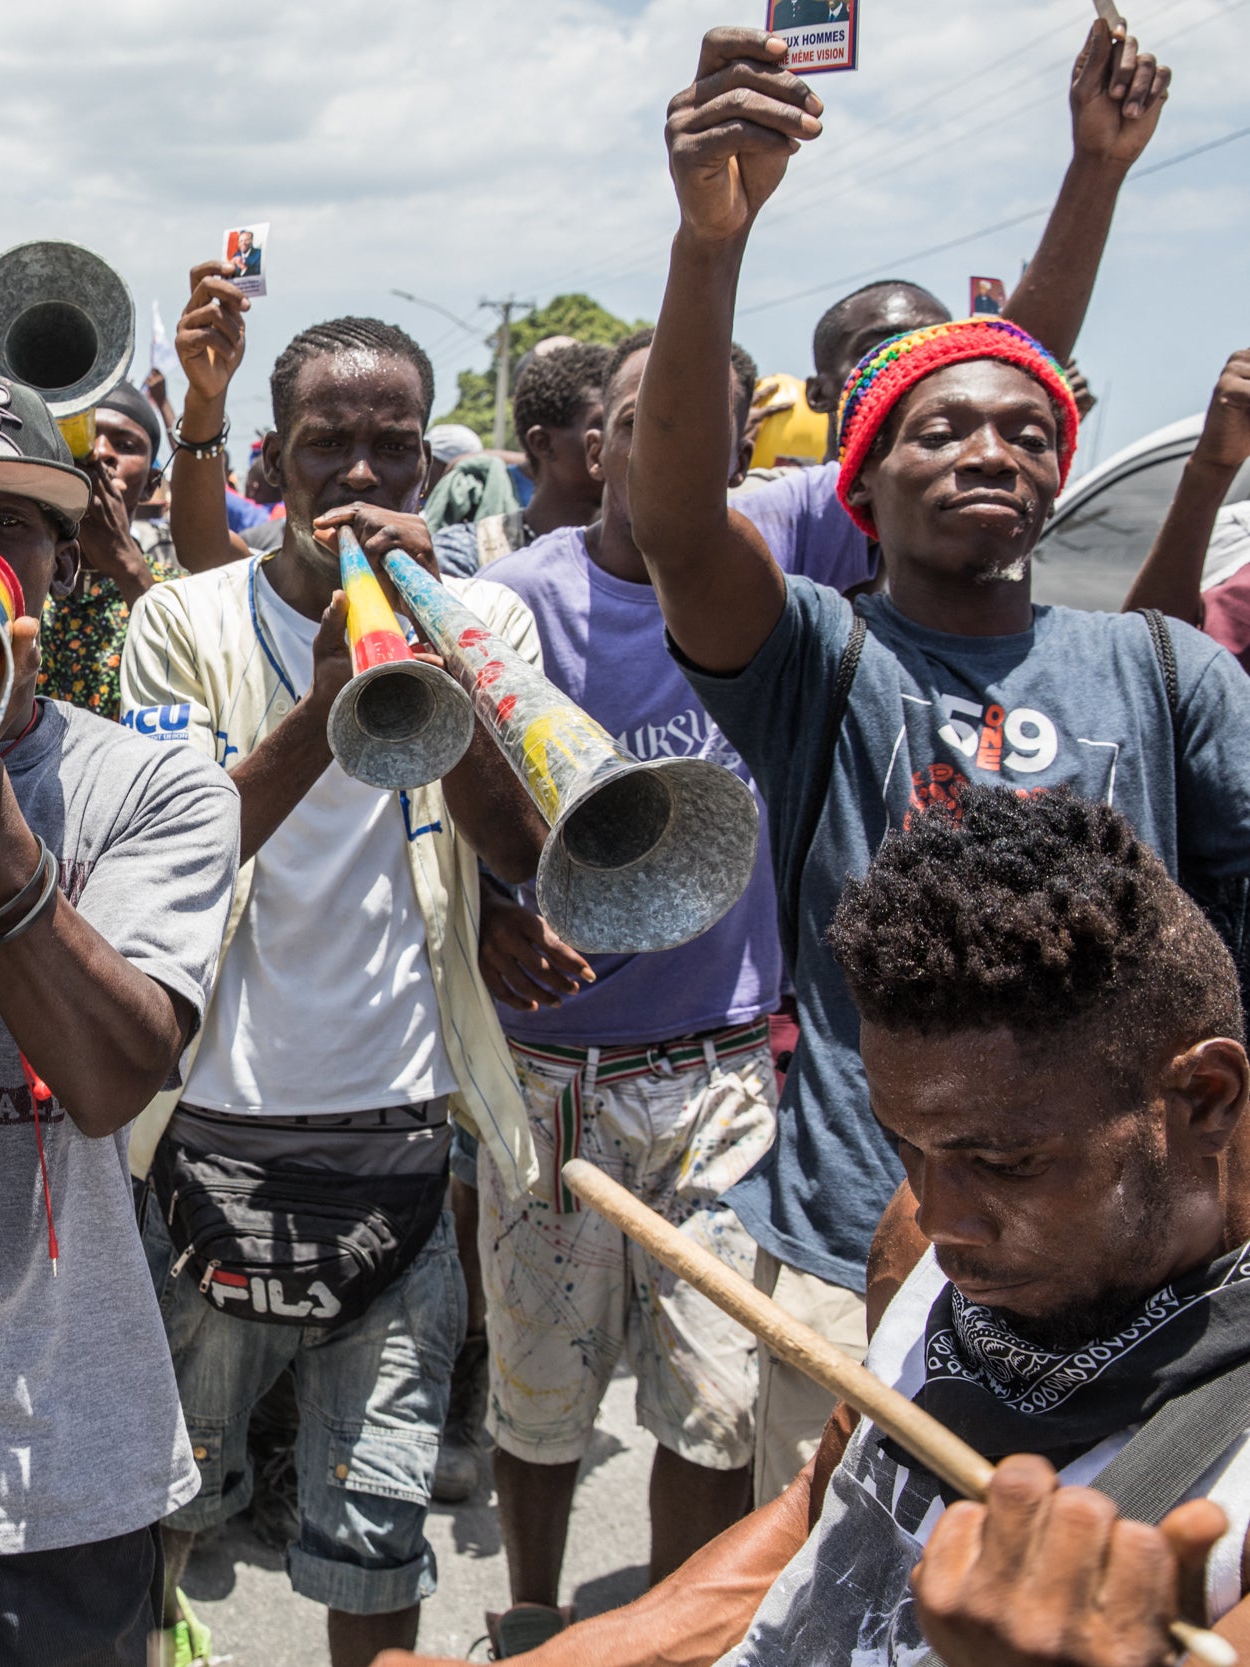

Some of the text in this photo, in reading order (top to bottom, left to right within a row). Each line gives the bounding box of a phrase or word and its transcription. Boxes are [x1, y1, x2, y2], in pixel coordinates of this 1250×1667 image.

[781, 29, 845, 48] UX HOMMES
[791, 49, 815, 64] MÊME
[816, 47, 845, 61] VISION
[209, 1270, 342, 1319] FILA
